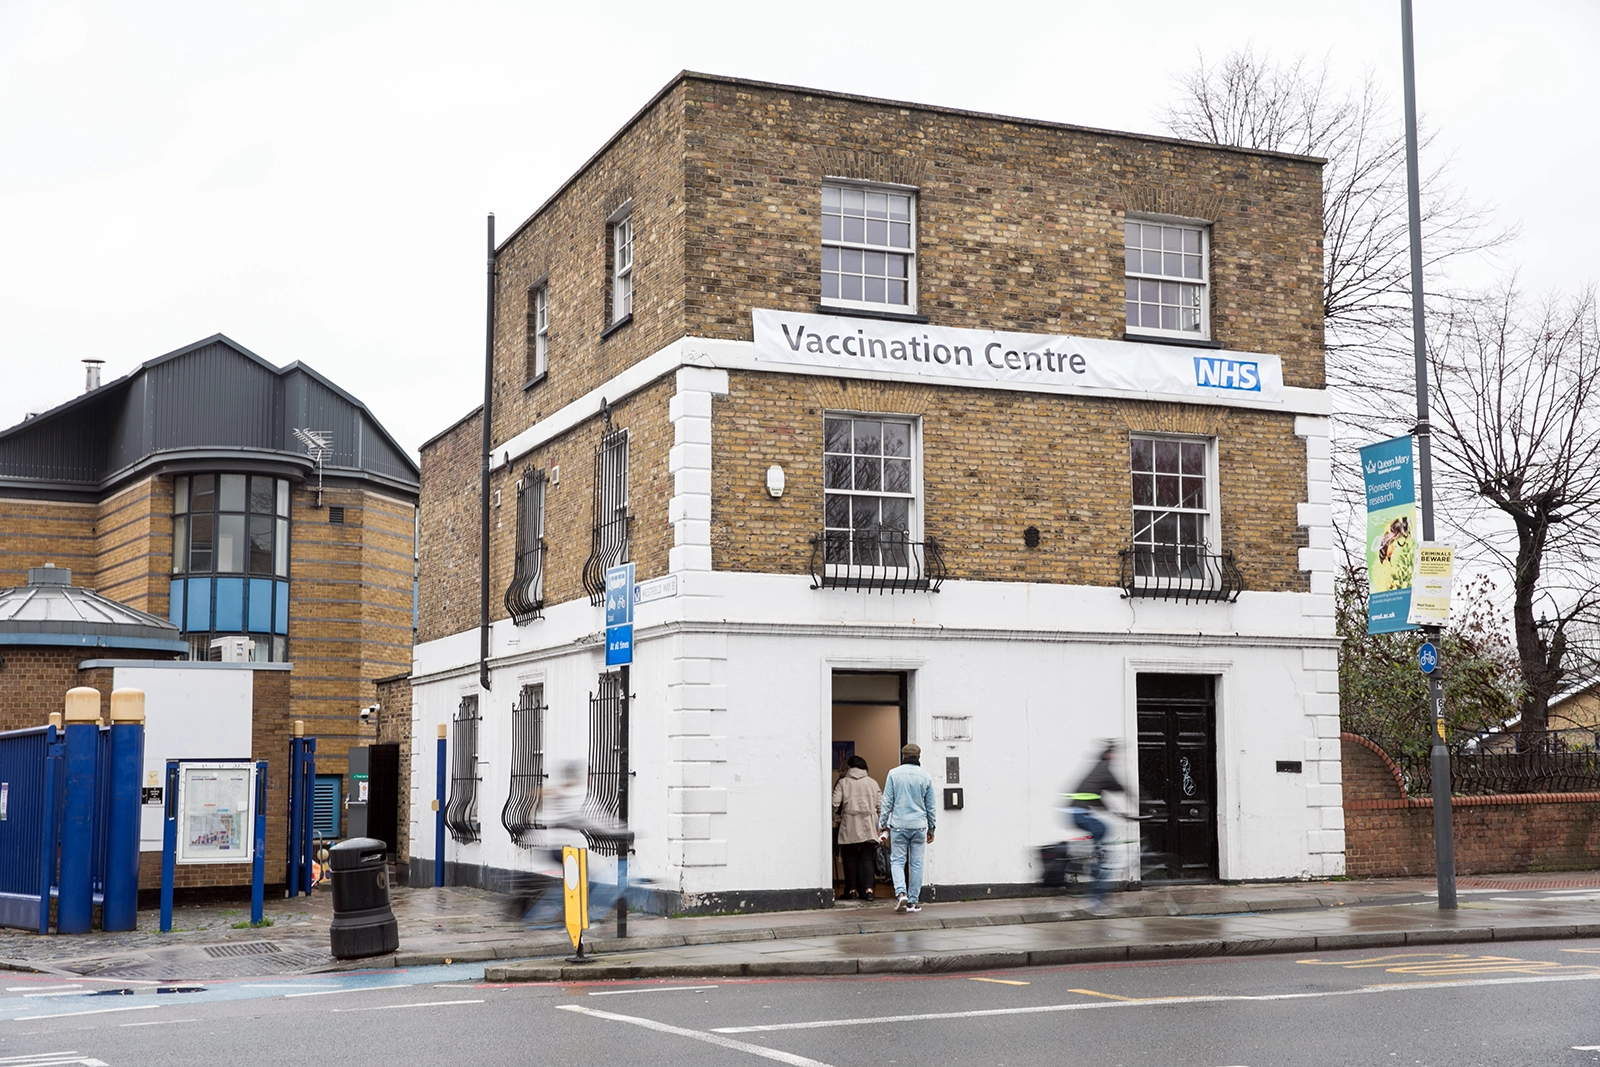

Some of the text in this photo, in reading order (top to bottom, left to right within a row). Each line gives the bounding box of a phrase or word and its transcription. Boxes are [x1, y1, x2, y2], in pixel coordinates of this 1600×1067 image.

[780, 323, 1087, 374] Vaccination Centre
[1196, 358, 1258, 389] NHS
[1377, 455, 1410, 469] Queen Mary
[1368, 479, 1402, 494] Pioneering
[1369, 491, 1394, 506] research
[663, 581, 671, 592] WAY
[1371, 612, 1395, 621] qmul.ac.uk
[610, 642, 614, 651] At
[620, 641, 629, 649] times
